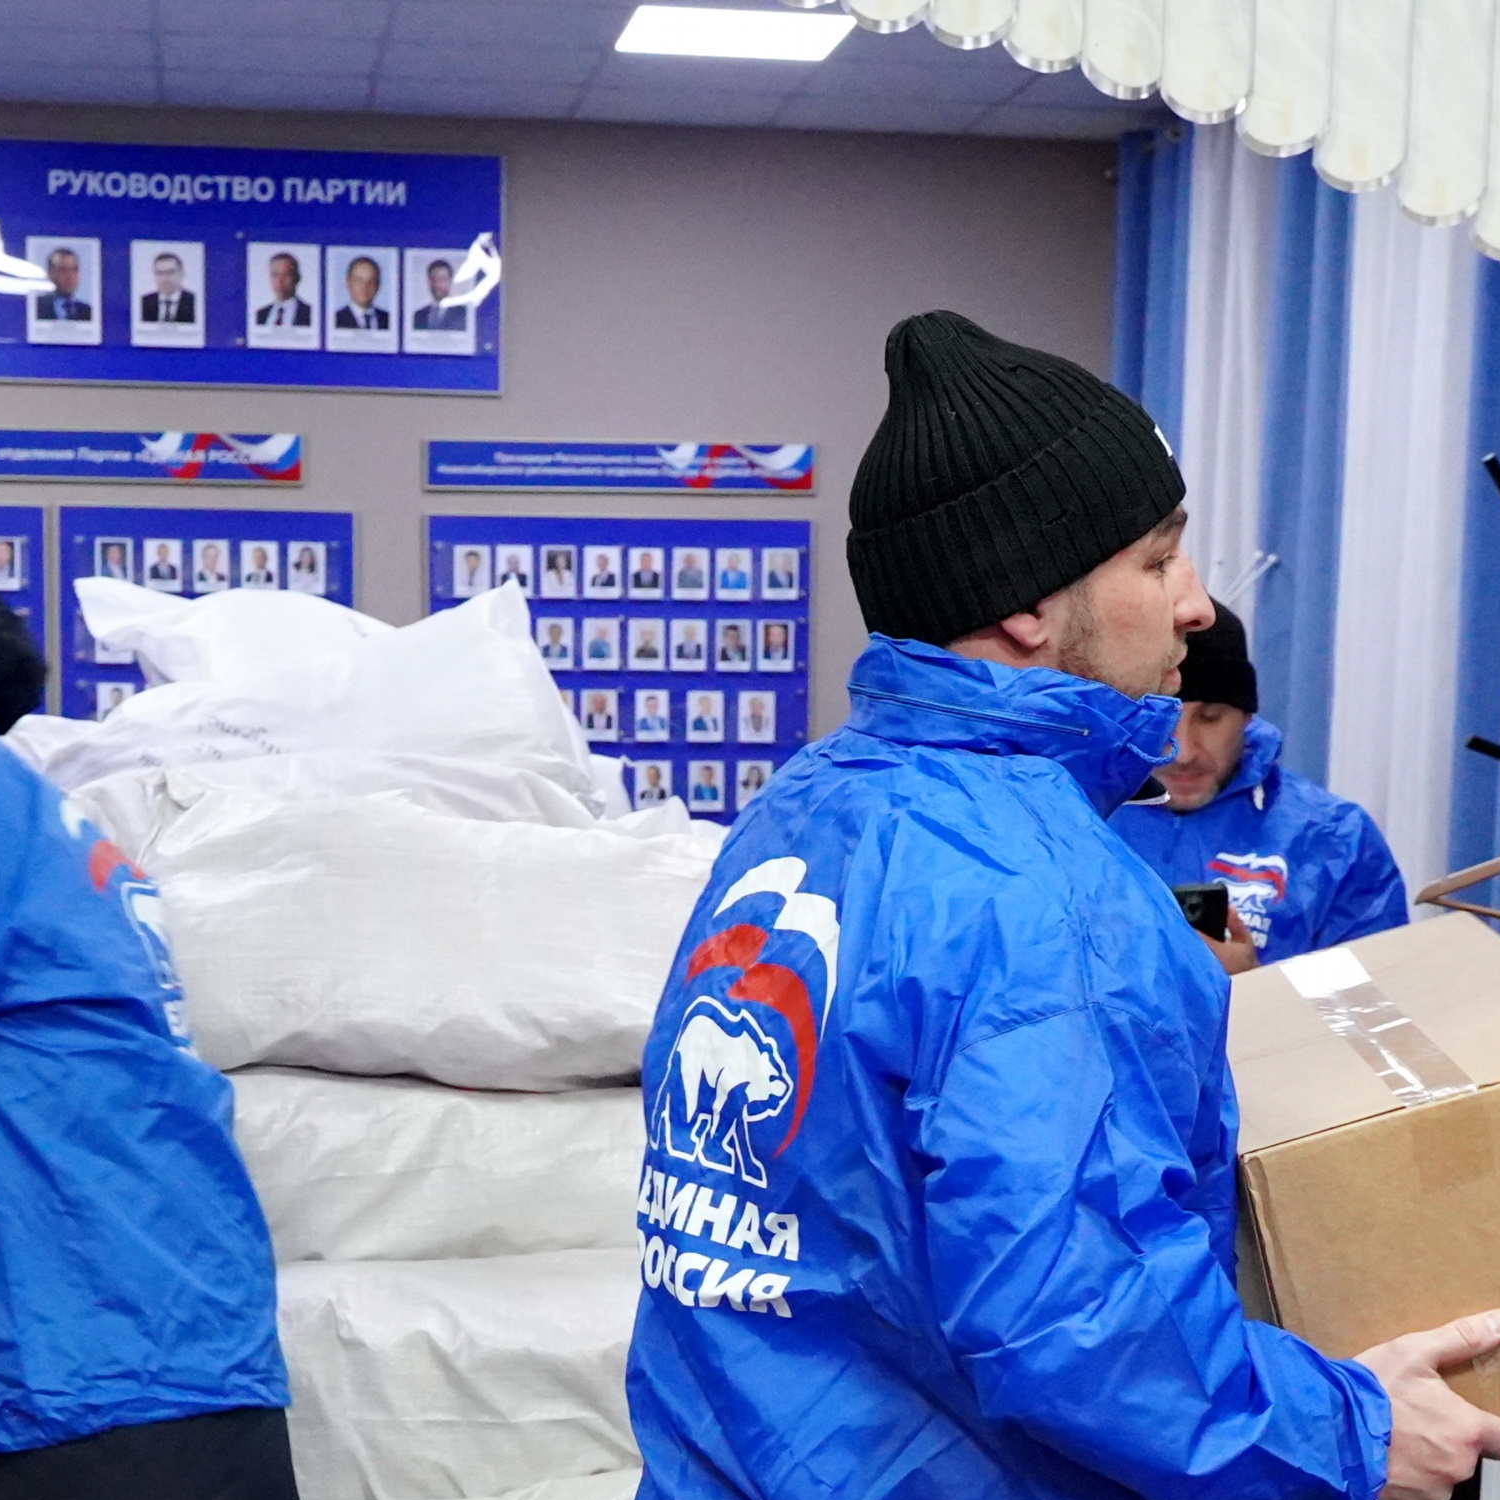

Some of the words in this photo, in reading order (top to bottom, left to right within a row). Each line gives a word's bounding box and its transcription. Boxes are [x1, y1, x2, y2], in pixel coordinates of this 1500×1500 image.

[47, 169, 275, 204] РУКОВОДСТВО
[283, 176, 407, 206] ПАРТИИ
[638, 1165, 799, 1261] ЕДИНАЯ
